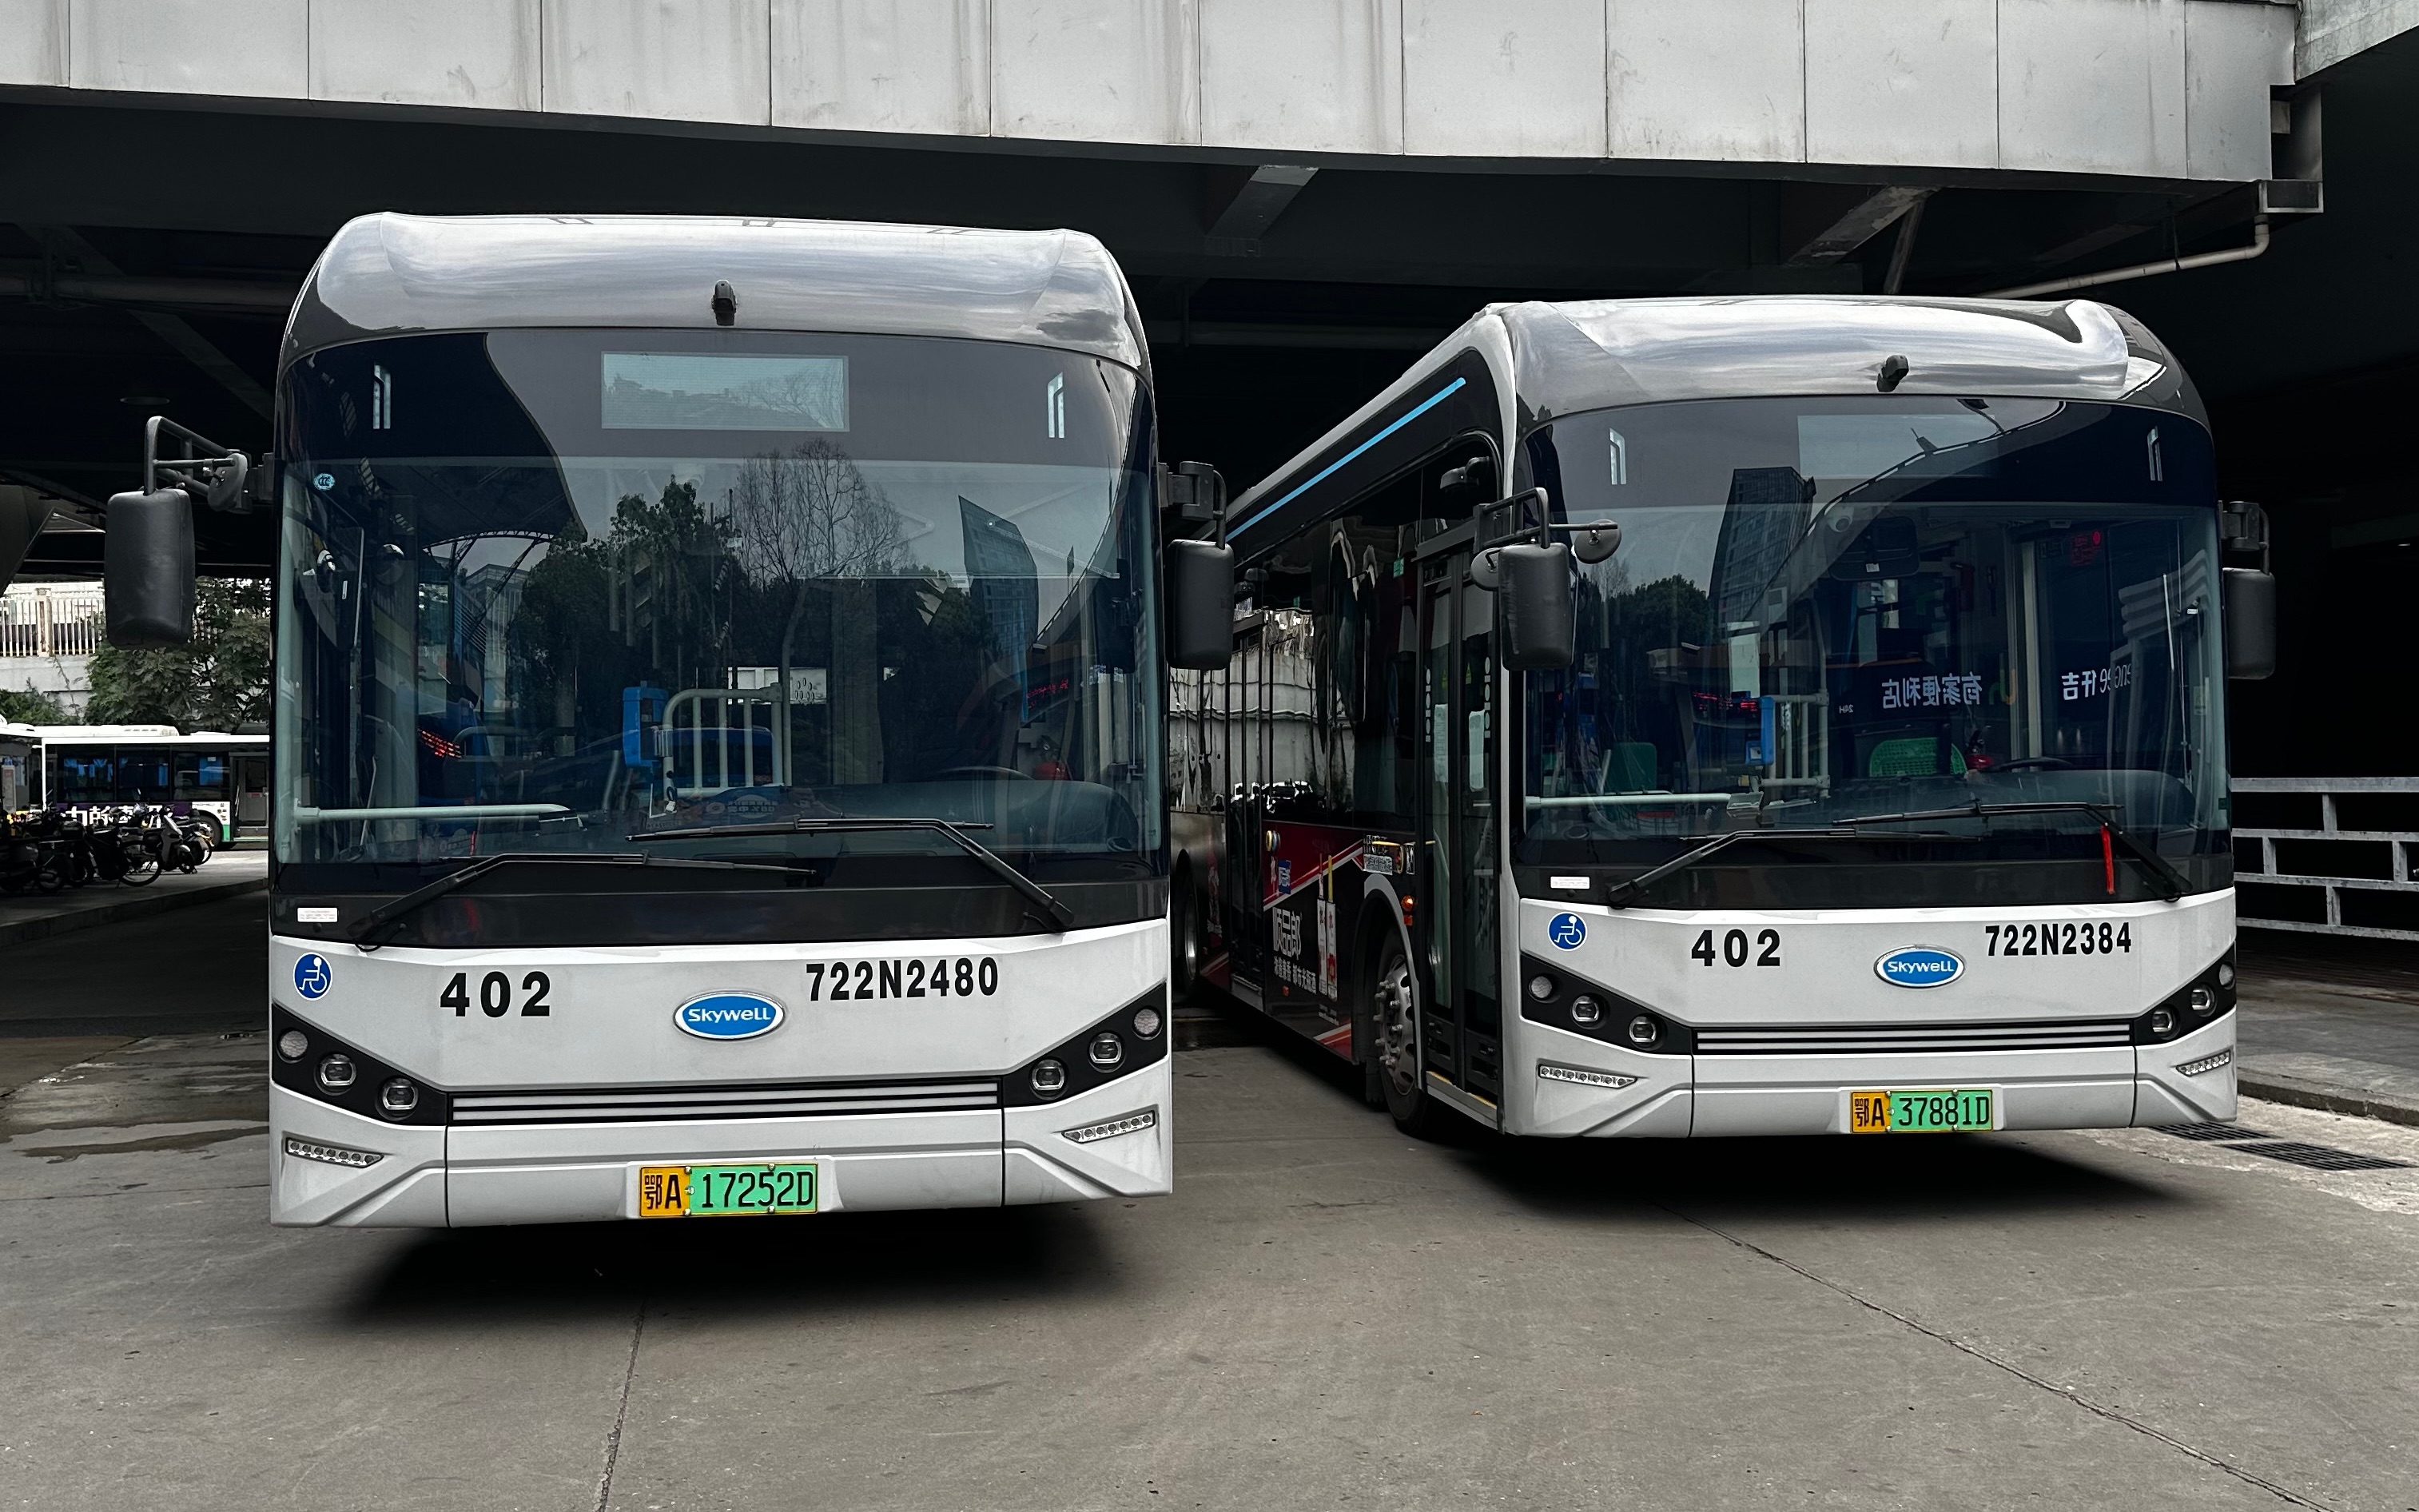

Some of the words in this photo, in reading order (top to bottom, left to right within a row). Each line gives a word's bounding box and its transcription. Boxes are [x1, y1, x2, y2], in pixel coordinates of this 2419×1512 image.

[1692, 929, 1780, 968] 402
[1986, 922, 2131, 957] 722N2384
[440, 972, 551, 1018] 402
[806, 957, 998, 1001] 722N2480
[1898, 1096, 1990, 1126] 37881D
[701, 1171, 814, 1208] 17252D
